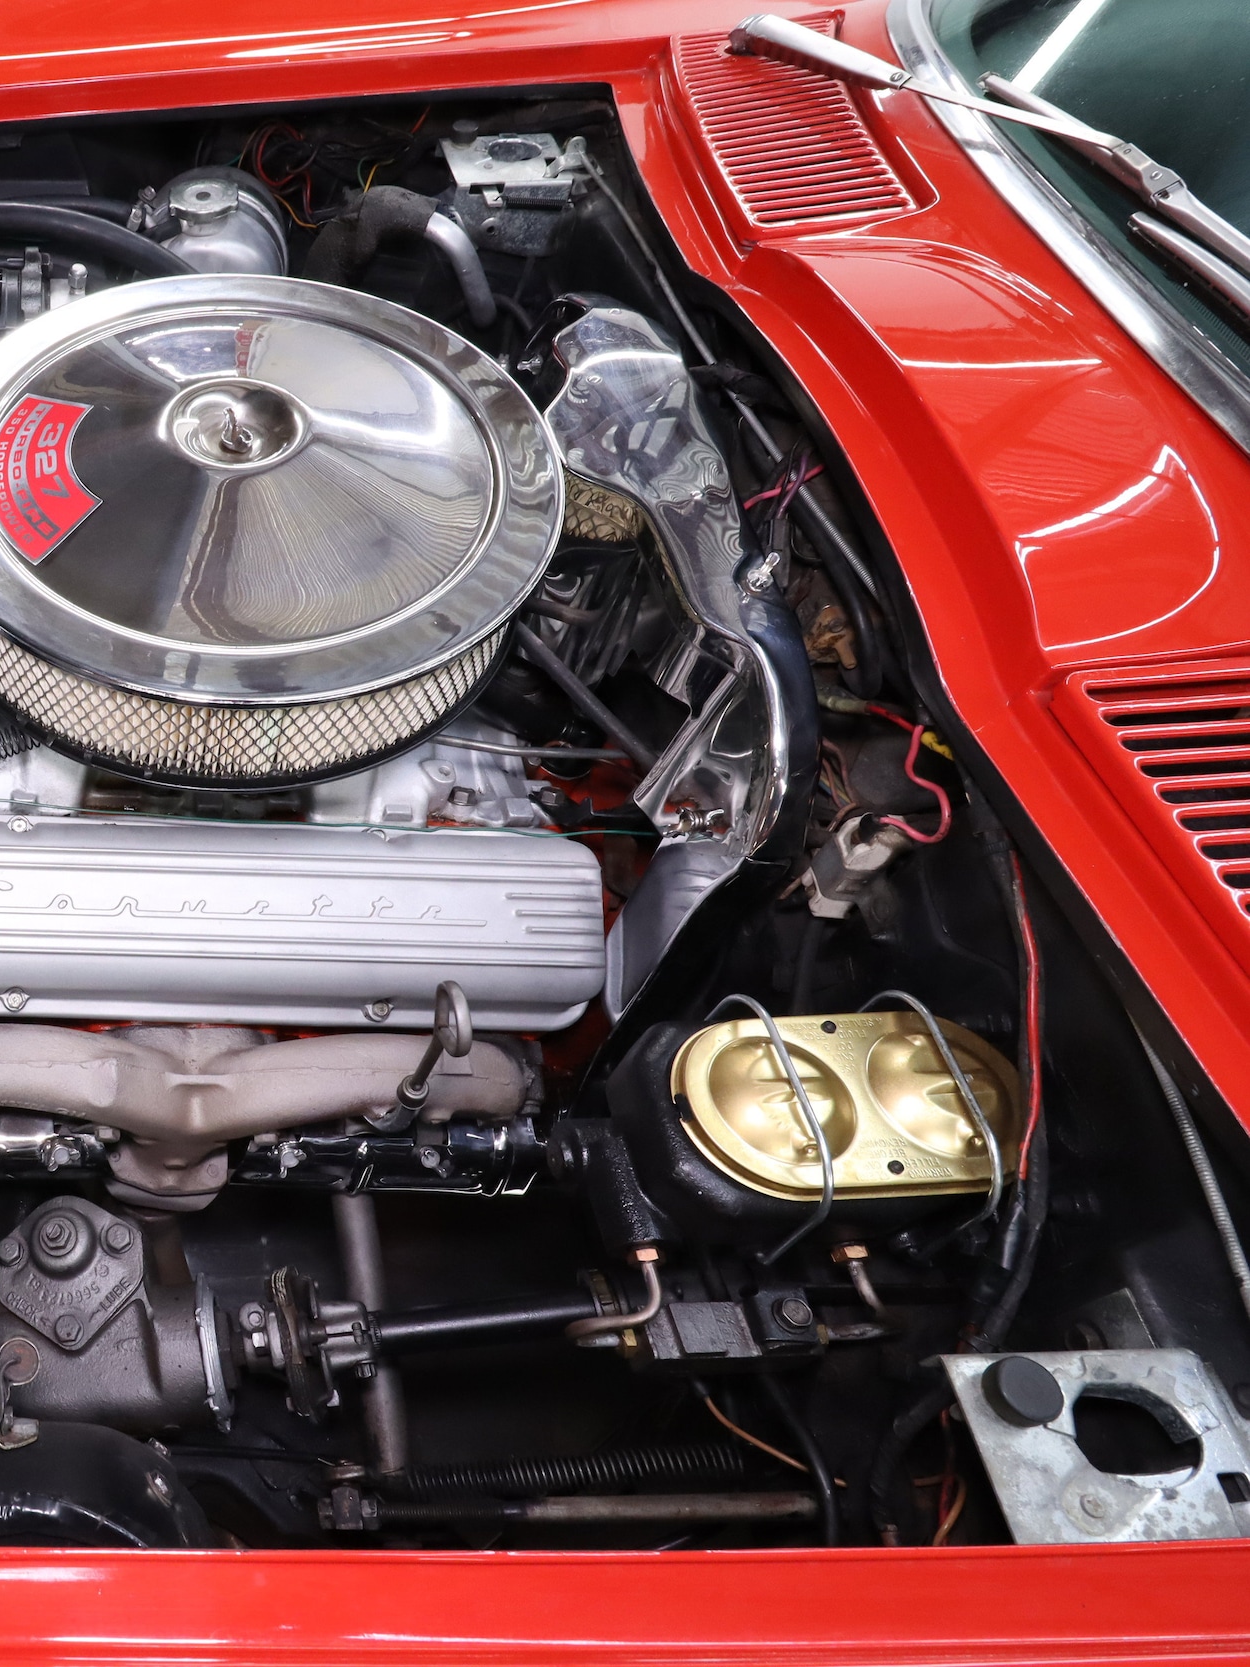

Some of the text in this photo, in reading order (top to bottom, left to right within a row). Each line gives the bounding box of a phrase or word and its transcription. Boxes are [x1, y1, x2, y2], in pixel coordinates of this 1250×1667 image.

[5, 408, 29, 435] 350
[34, 422, 70, 498] 327
[99, 1276, 132, 1314] LUBE
